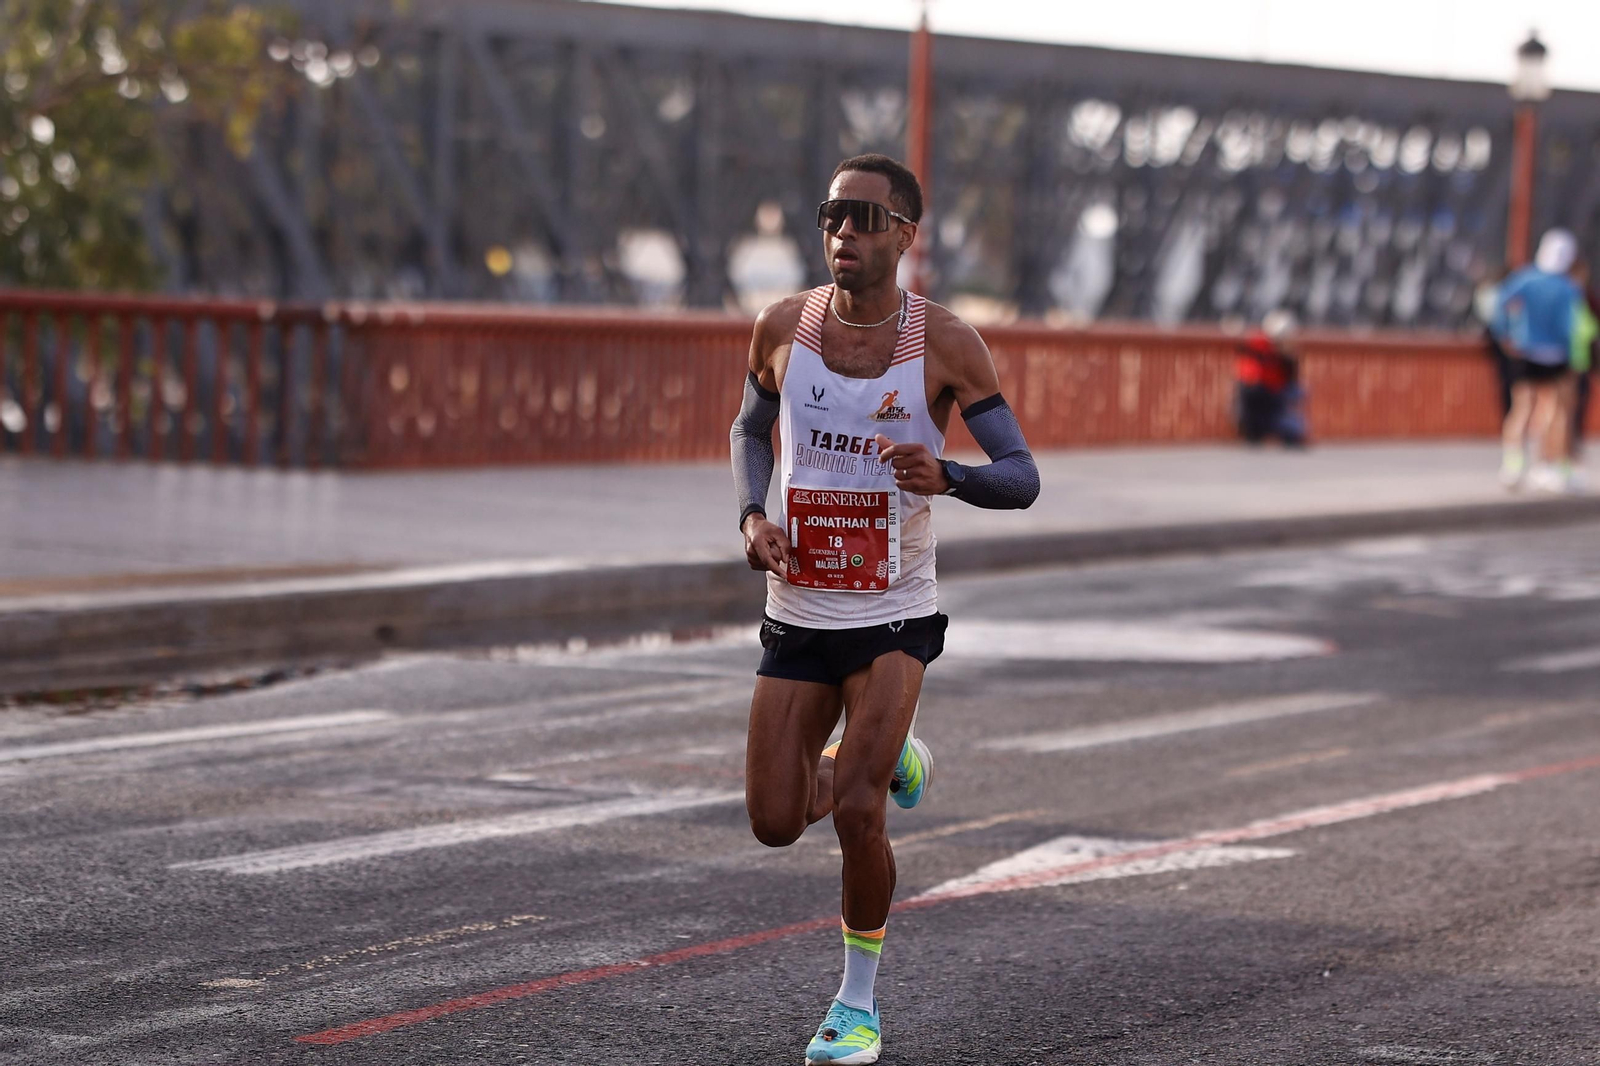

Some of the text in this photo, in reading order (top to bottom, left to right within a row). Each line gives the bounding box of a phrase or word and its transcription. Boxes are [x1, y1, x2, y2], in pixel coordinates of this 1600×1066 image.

[796, 444, 857, 475] RUNNING
[812, 492, 880, 506] GENERALI
[804, 516, 870, 528] JONATHAN
[828, 536, 843, 548] 18
[816, 560, 840, 570] MÁLAGA
